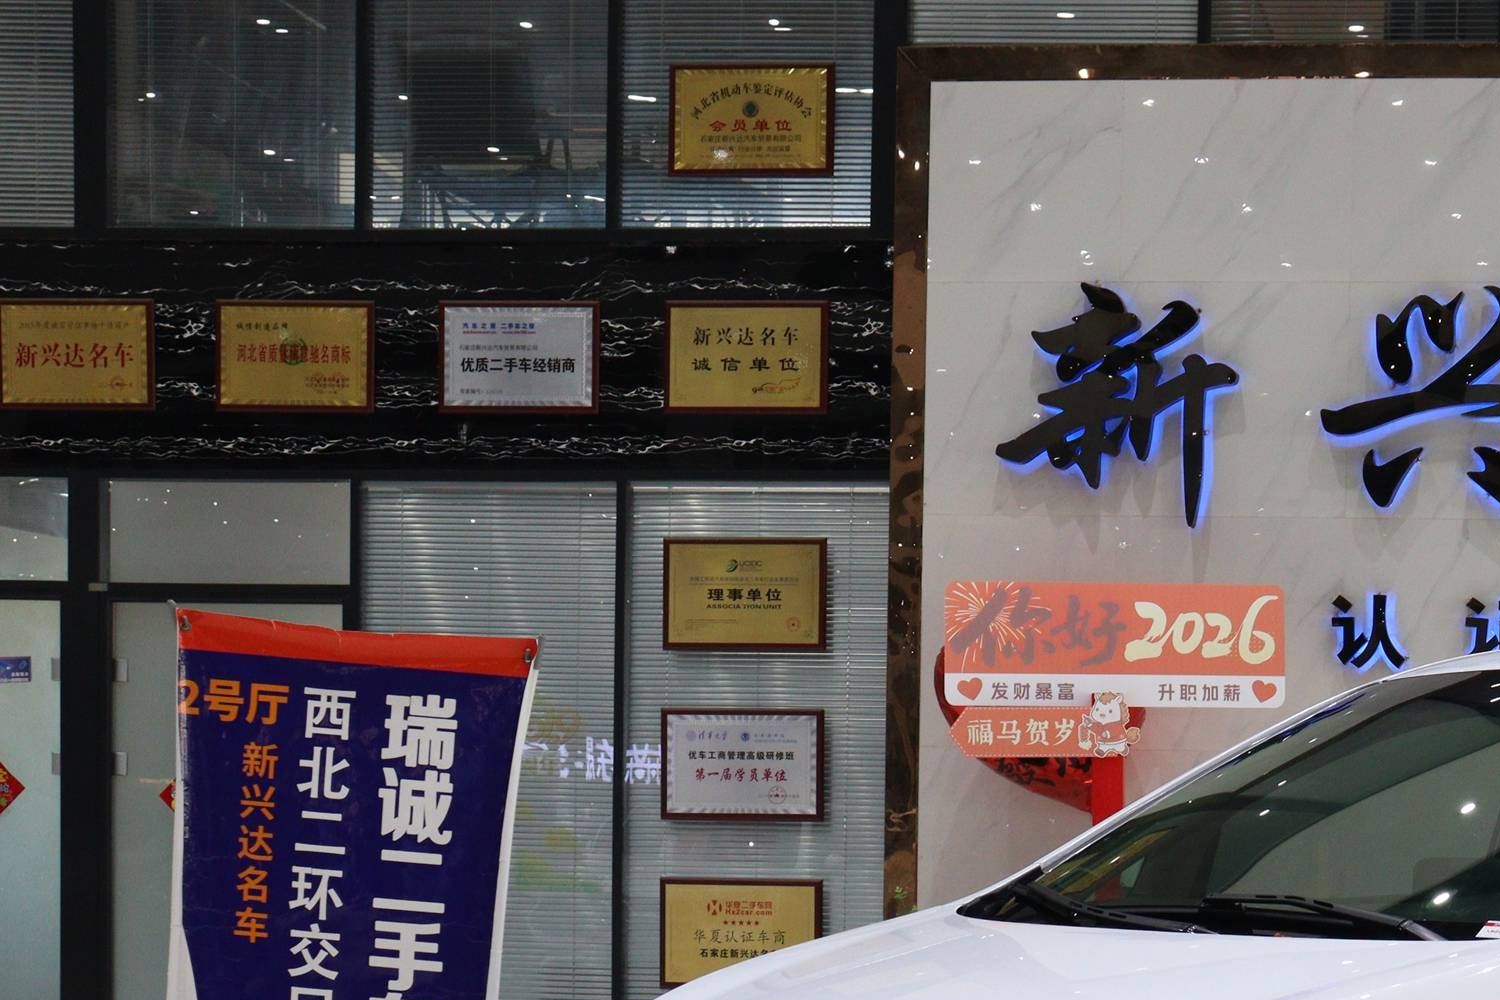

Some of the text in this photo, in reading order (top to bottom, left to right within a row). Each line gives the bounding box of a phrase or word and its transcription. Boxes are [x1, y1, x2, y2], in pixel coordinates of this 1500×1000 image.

[709, 119, 792, 132] 会员单位
[693, 327, 799, 346] 新兴达名车
[15, 342, 134, 368] 新兴达名车
[461, 357, 576, 373] 优质二手车经销商
[691, 357, 800, 371] 诚信单位
[707, 588, 782, 601] 理事单位
[1124, 595, 1279, 664] 2026
[991, 682, 1241, 702] 发财暴富 升职加薪
[177, 678, 290, 725] 2号厅
[967, 719, 1075, 747] 福马贺岁
[688, 751, 794, 760] 优车工商管理高级研修班
[695, 767, 788, 782] 第一届学员单位
[233, 742, 279, 943] 新兴达名车
[693, 929, 786, 945] 华夏认证车商
